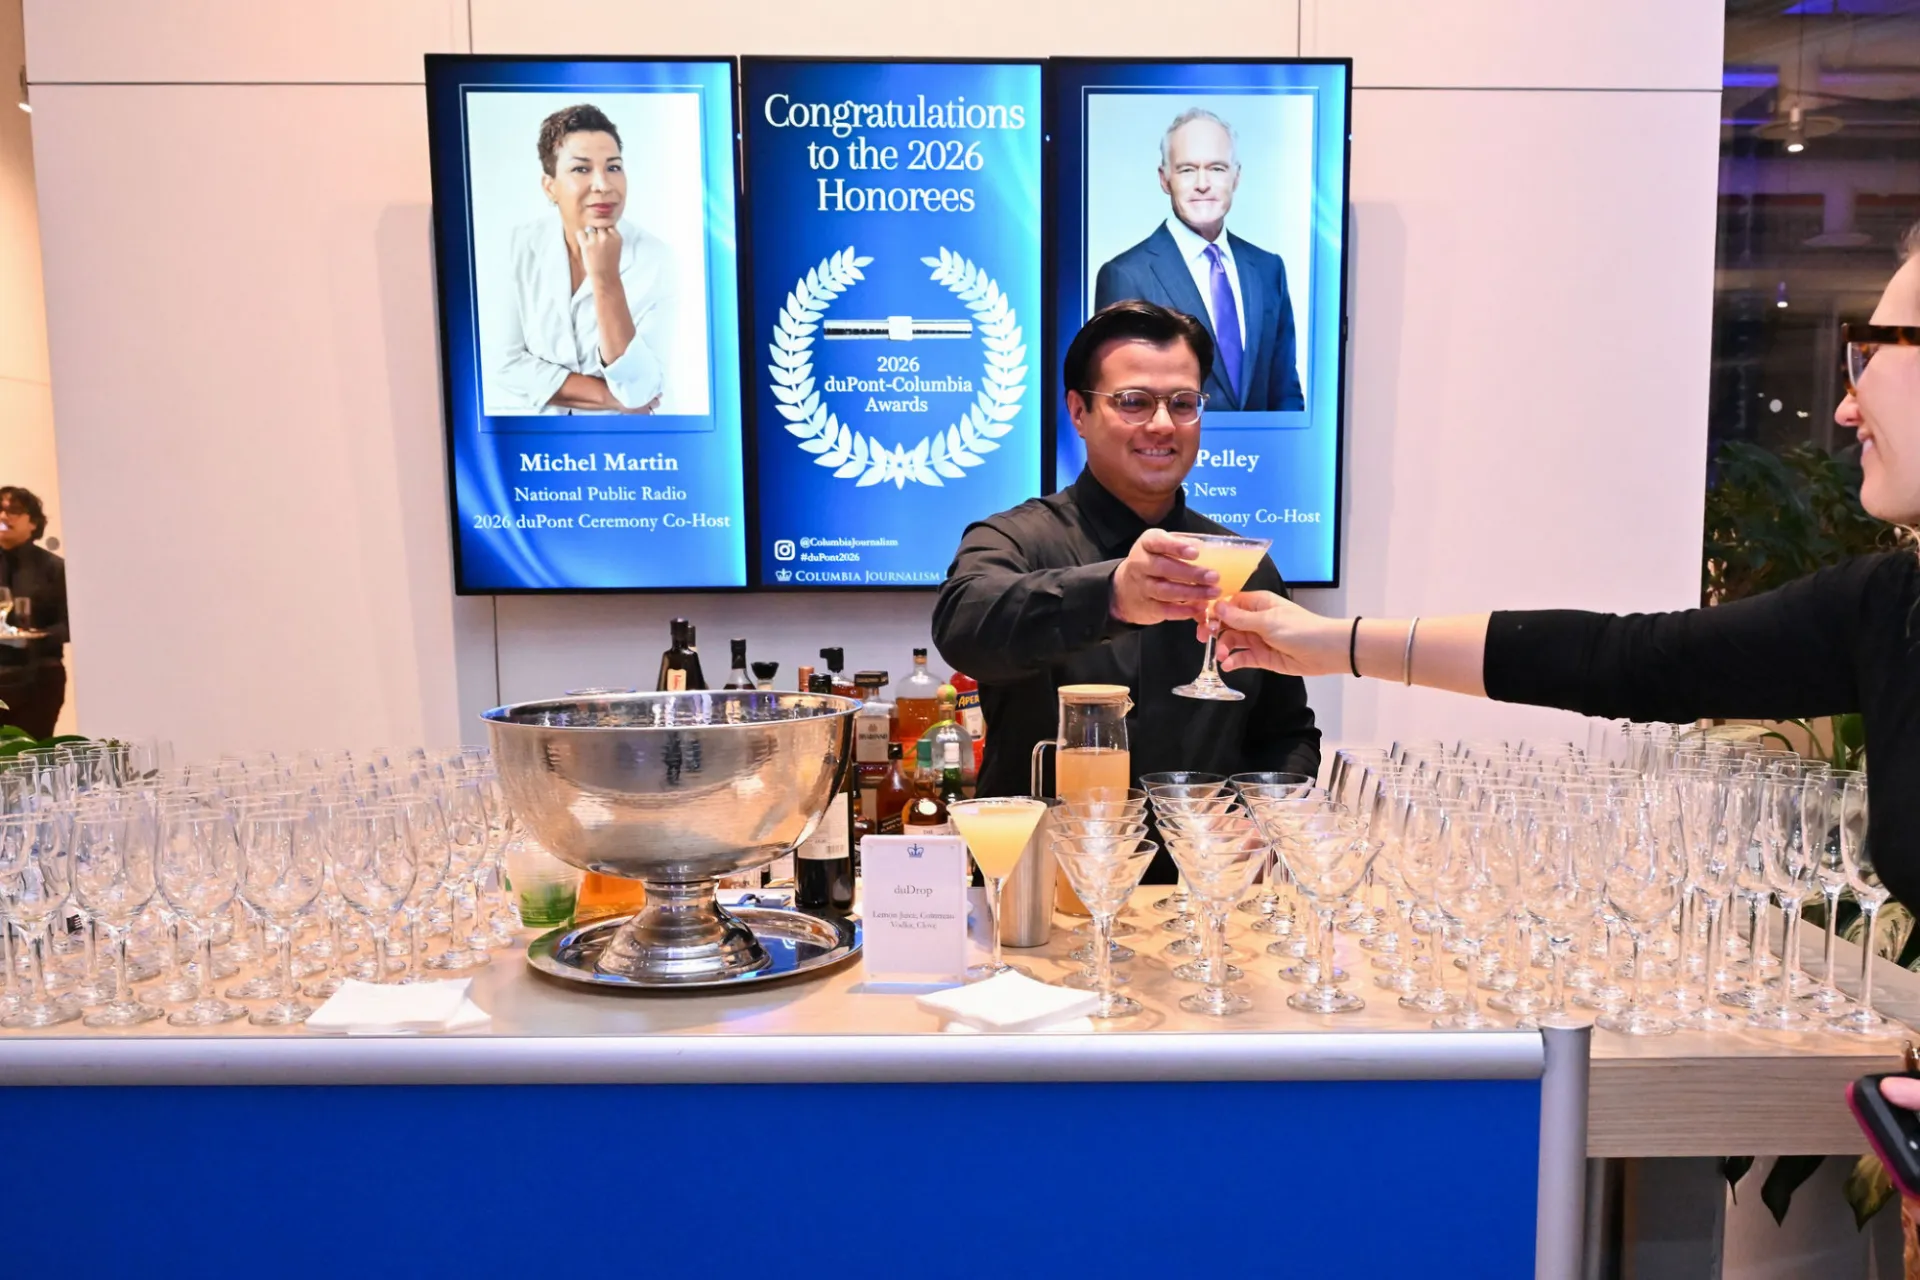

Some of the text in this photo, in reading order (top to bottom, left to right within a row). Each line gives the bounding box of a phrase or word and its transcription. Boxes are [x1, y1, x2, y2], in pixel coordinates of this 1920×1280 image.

[764, 93, 1026, 138] Congratulations
[807, 136, 984, 171] to the 2026
[816, 178, 976, 212] Honorees
[877, 356, 920, 372] 2026
[824, 375, 973, 392] duPont-Columbia
[864, 396, 929, 412] Awards
[520, 453, 679, 472] Michel Martin
[1195, 449, 1260, 473] Pelley
[514, 486, 687, 502] National Public Radio
[1194, 482, 1237, 497] News
[473, 513, 731, 532] 2026 duPont Ceremony Co-Host
[1201, 508, 1321, 528] mony Co-Host
[800, 536, 899, 548] @ColumbiaJournalism
[800, 552, 860, 562] #duPont2026
[958, 694, 980, 708] APER
[893, 884, 933, 897] duDrop
